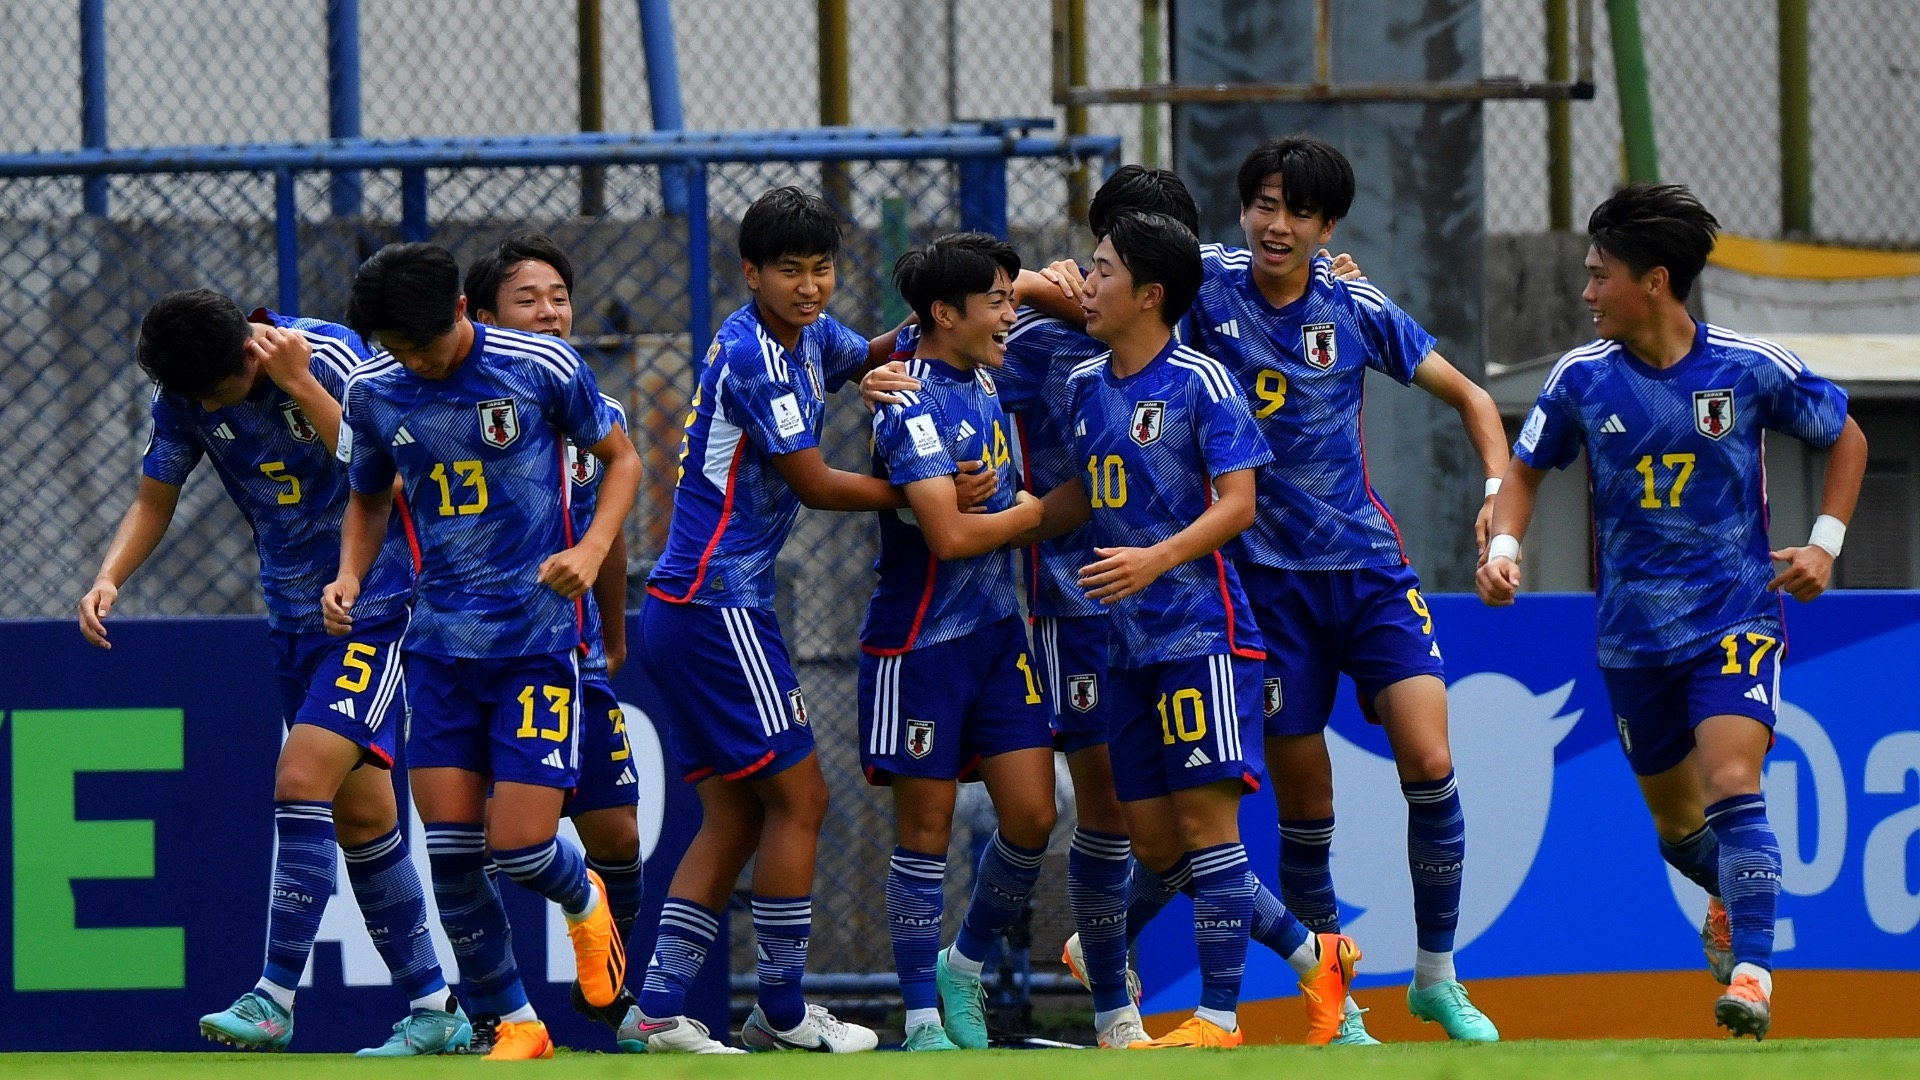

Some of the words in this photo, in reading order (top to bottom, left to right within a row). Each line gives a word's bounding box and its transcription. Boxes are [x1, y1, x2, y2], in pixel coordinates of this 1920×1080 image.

[1255, 369, 1287, 419] 9
[260, 461, 302, 505] 5
[430, 460, 489, 516] 13
[1087, 455, 1127, 508] 10
[1636, 453, 1696, 508] 17
[1406, 589, 1432, 635] 9
[336, 642, 377, 693] 5
[1016, 653, 1043, 705] 1
[1721, 633, 1777, 677] 17
[517, 685, 571, 742] 13
[608, 708, 630, 761] 3
[1157, 687, 1207, 745] 10
[0, 708, 186, 991] E
[273, 889, 313, 904] PAN
